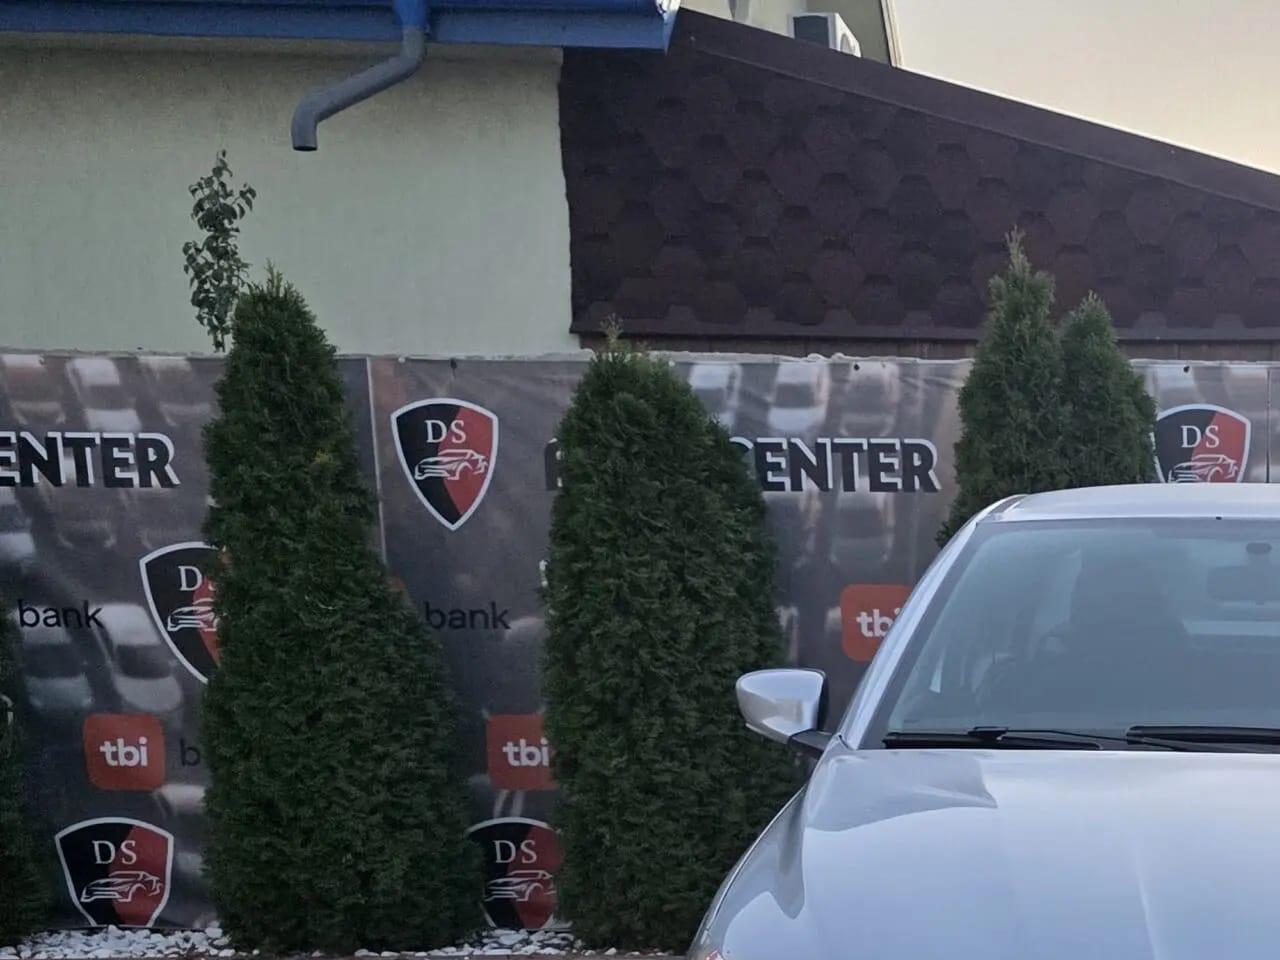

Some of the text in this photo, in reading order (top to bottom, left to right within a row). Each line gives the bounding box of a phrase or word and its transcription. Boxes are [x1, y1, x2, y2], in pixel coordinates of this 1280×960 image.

[426, 419, 466, 444] DS
[1181, 424, 1220, 449] DS
[729, 437, 942, 492] ENTER
[19, 602, 104, 629] bank
[423, 601, 511, 630] bank
[856, 607, 900, 637] tb
[100, 737, 148, 767] tbi
[502, 737, 549, 767] tbi
[92, 840, 137, 865] DS
[494, 839, 537, 864] DS
